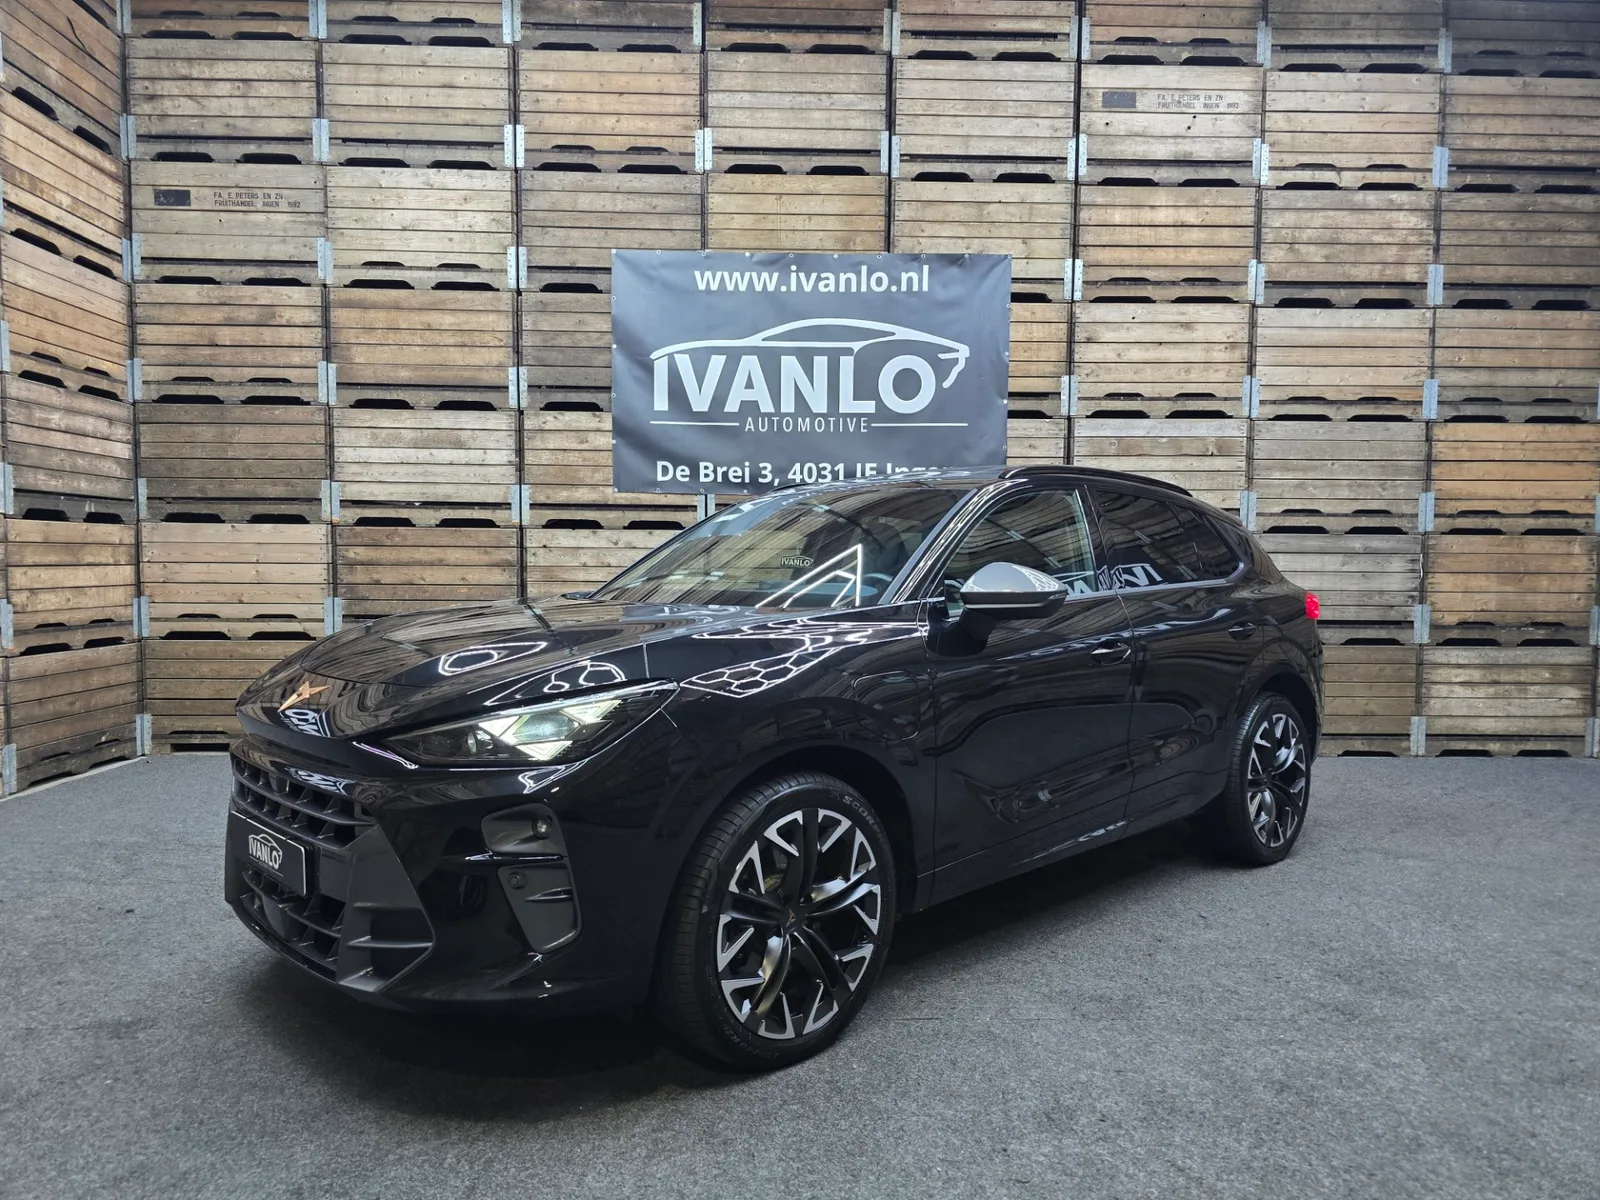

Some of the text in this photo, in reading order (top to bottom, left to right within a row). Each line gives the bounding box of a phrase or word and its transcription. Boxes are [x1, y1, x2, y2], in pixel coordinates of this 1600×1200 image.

[214, 200, 255, 208] FRUITHANDEL
[235, 192, 259, 200] PETERS
[262, 192, 271, 200] EN
[694, 265, 929, 293] www.ivanlo.nl
[653, 354, 936, 414] IVANLO
[745, 416, 868, 433] AUTOMOTIVE
[656, 461, 690, 482] De
[699, 461, 751, 483] Brei
[758, 462, 780, 486] 3,
[787, 462, 845, 482] 4031
[781, 557, 811, 567] IVANLO
[248, 837, 280, 869] IVANLO
